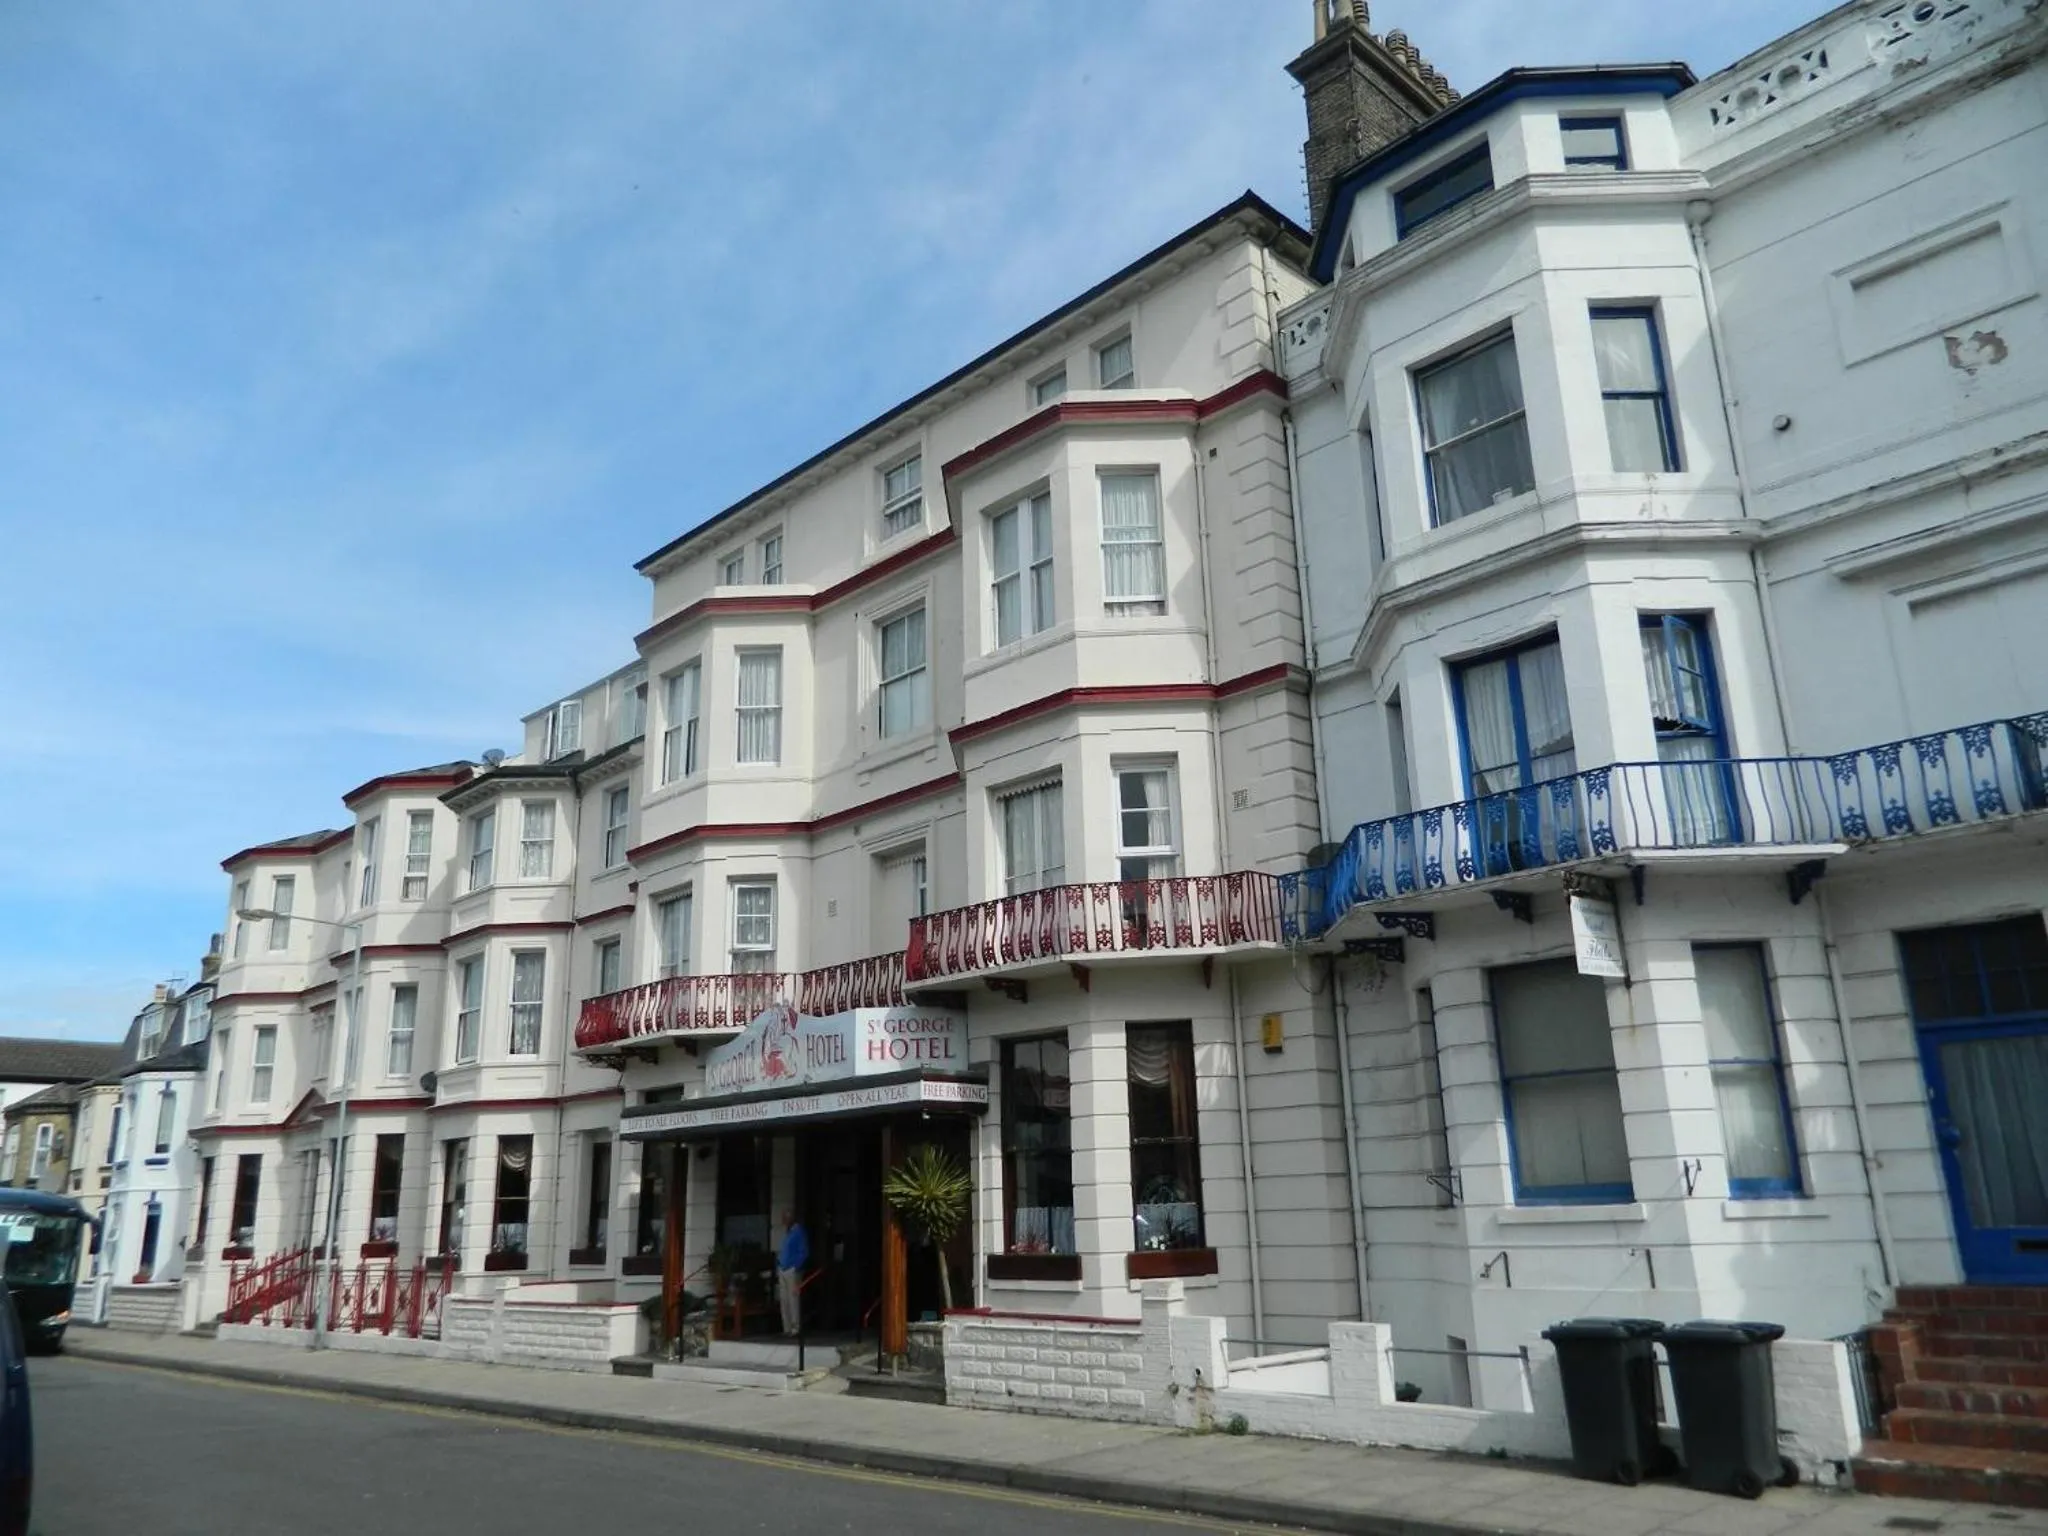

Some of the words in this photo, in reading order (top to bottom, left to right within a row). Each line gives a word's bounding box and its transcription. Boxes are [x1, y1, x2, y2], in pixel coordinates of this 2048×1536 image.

[884, 1017, 954, 1034] GEORGE
[720, 1039, 756, 1088] GEORGE
[805, 1031, 847, 1069] HOTEL
[867, 1037, 957, 1061] HOTEL
[710, 1109, 729, 1121] FREE
[731, 1103, 768, 1119] PARKING
[837, 1093, 863, 1107] OPEN
[864, 1090, 881, 1104] ALL
[882, 1086, 909, 1100] YEAR
[923, 1083, 944, 1097] FREE
[946, 1085, 986, 1100] PARKING
